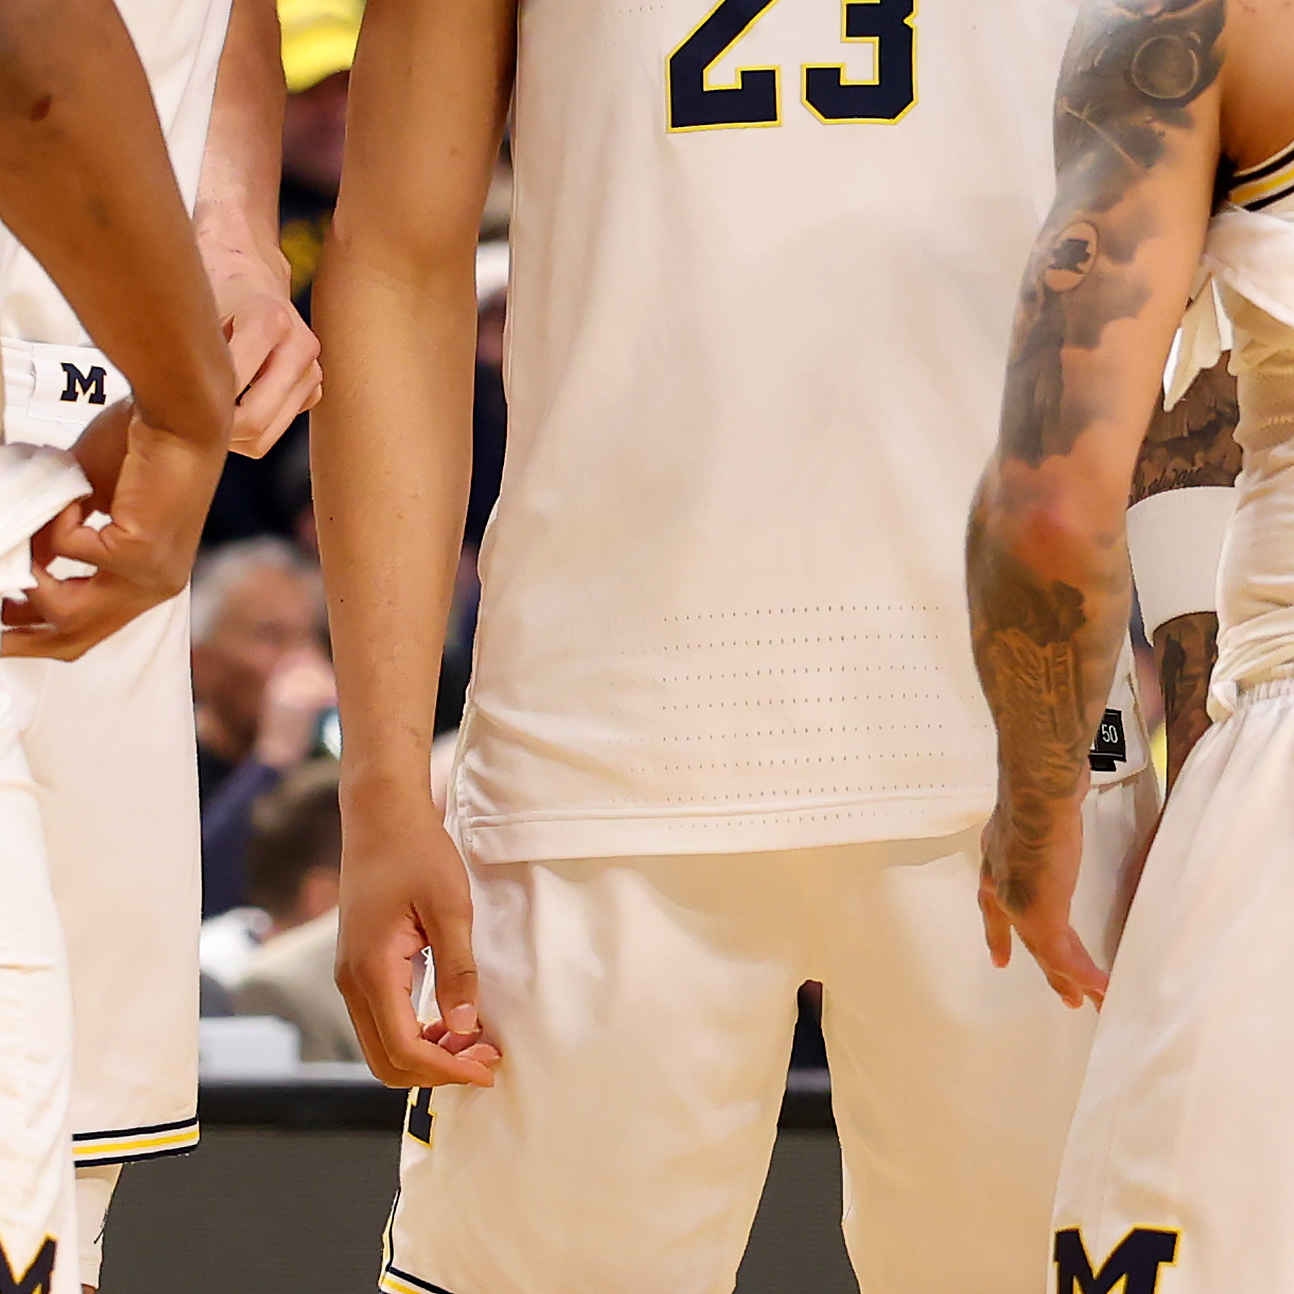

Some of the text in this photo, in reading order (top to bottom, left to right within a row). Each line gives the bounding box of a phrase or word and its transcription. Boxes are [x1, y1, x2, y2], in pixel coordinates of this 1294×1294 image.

[60, 362, 107, 405] M
[1101, 724, 1118, 743] 50
[1054, 1223, 1183, 1294] M
